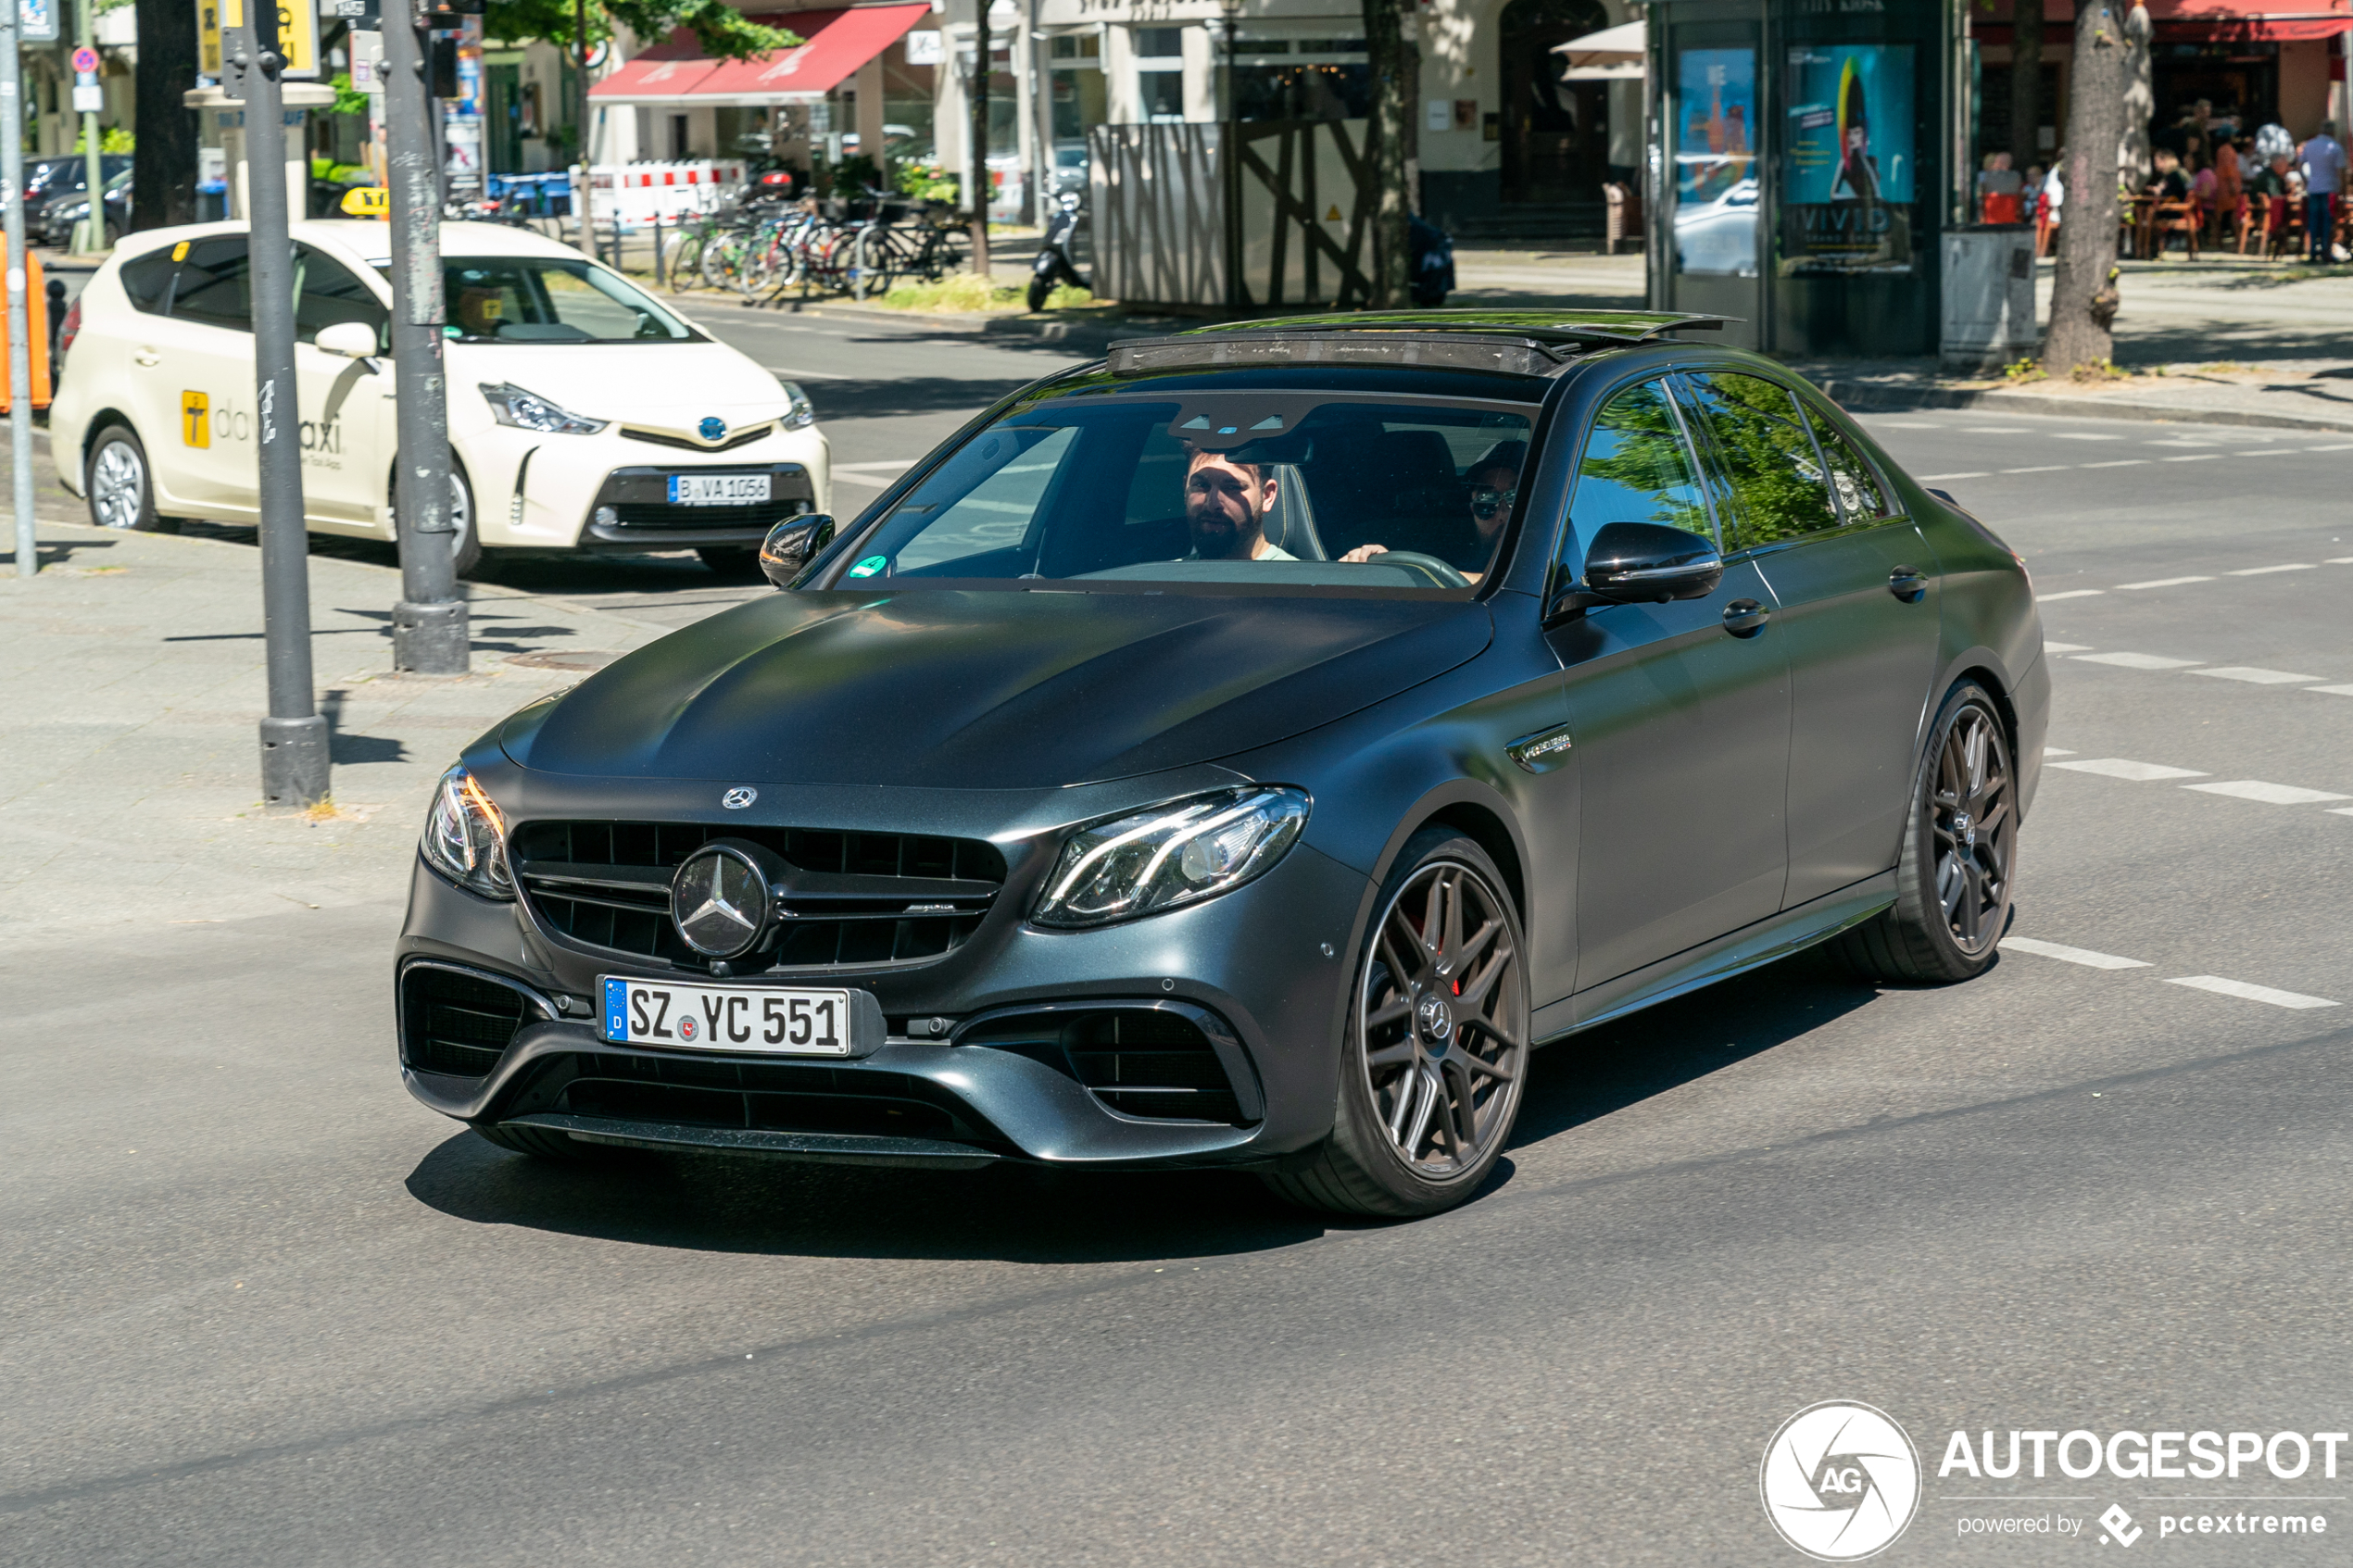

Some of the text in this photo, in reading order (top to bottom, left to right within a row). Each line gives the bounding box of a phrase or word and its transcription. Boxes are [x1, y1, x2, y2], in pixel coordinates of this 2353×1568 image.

[1800, 207, 1890, 232] VIVID
[681, 479, 767, 498] B VA 1056
[613, 989, 839, 1047] D SZ YC 551
